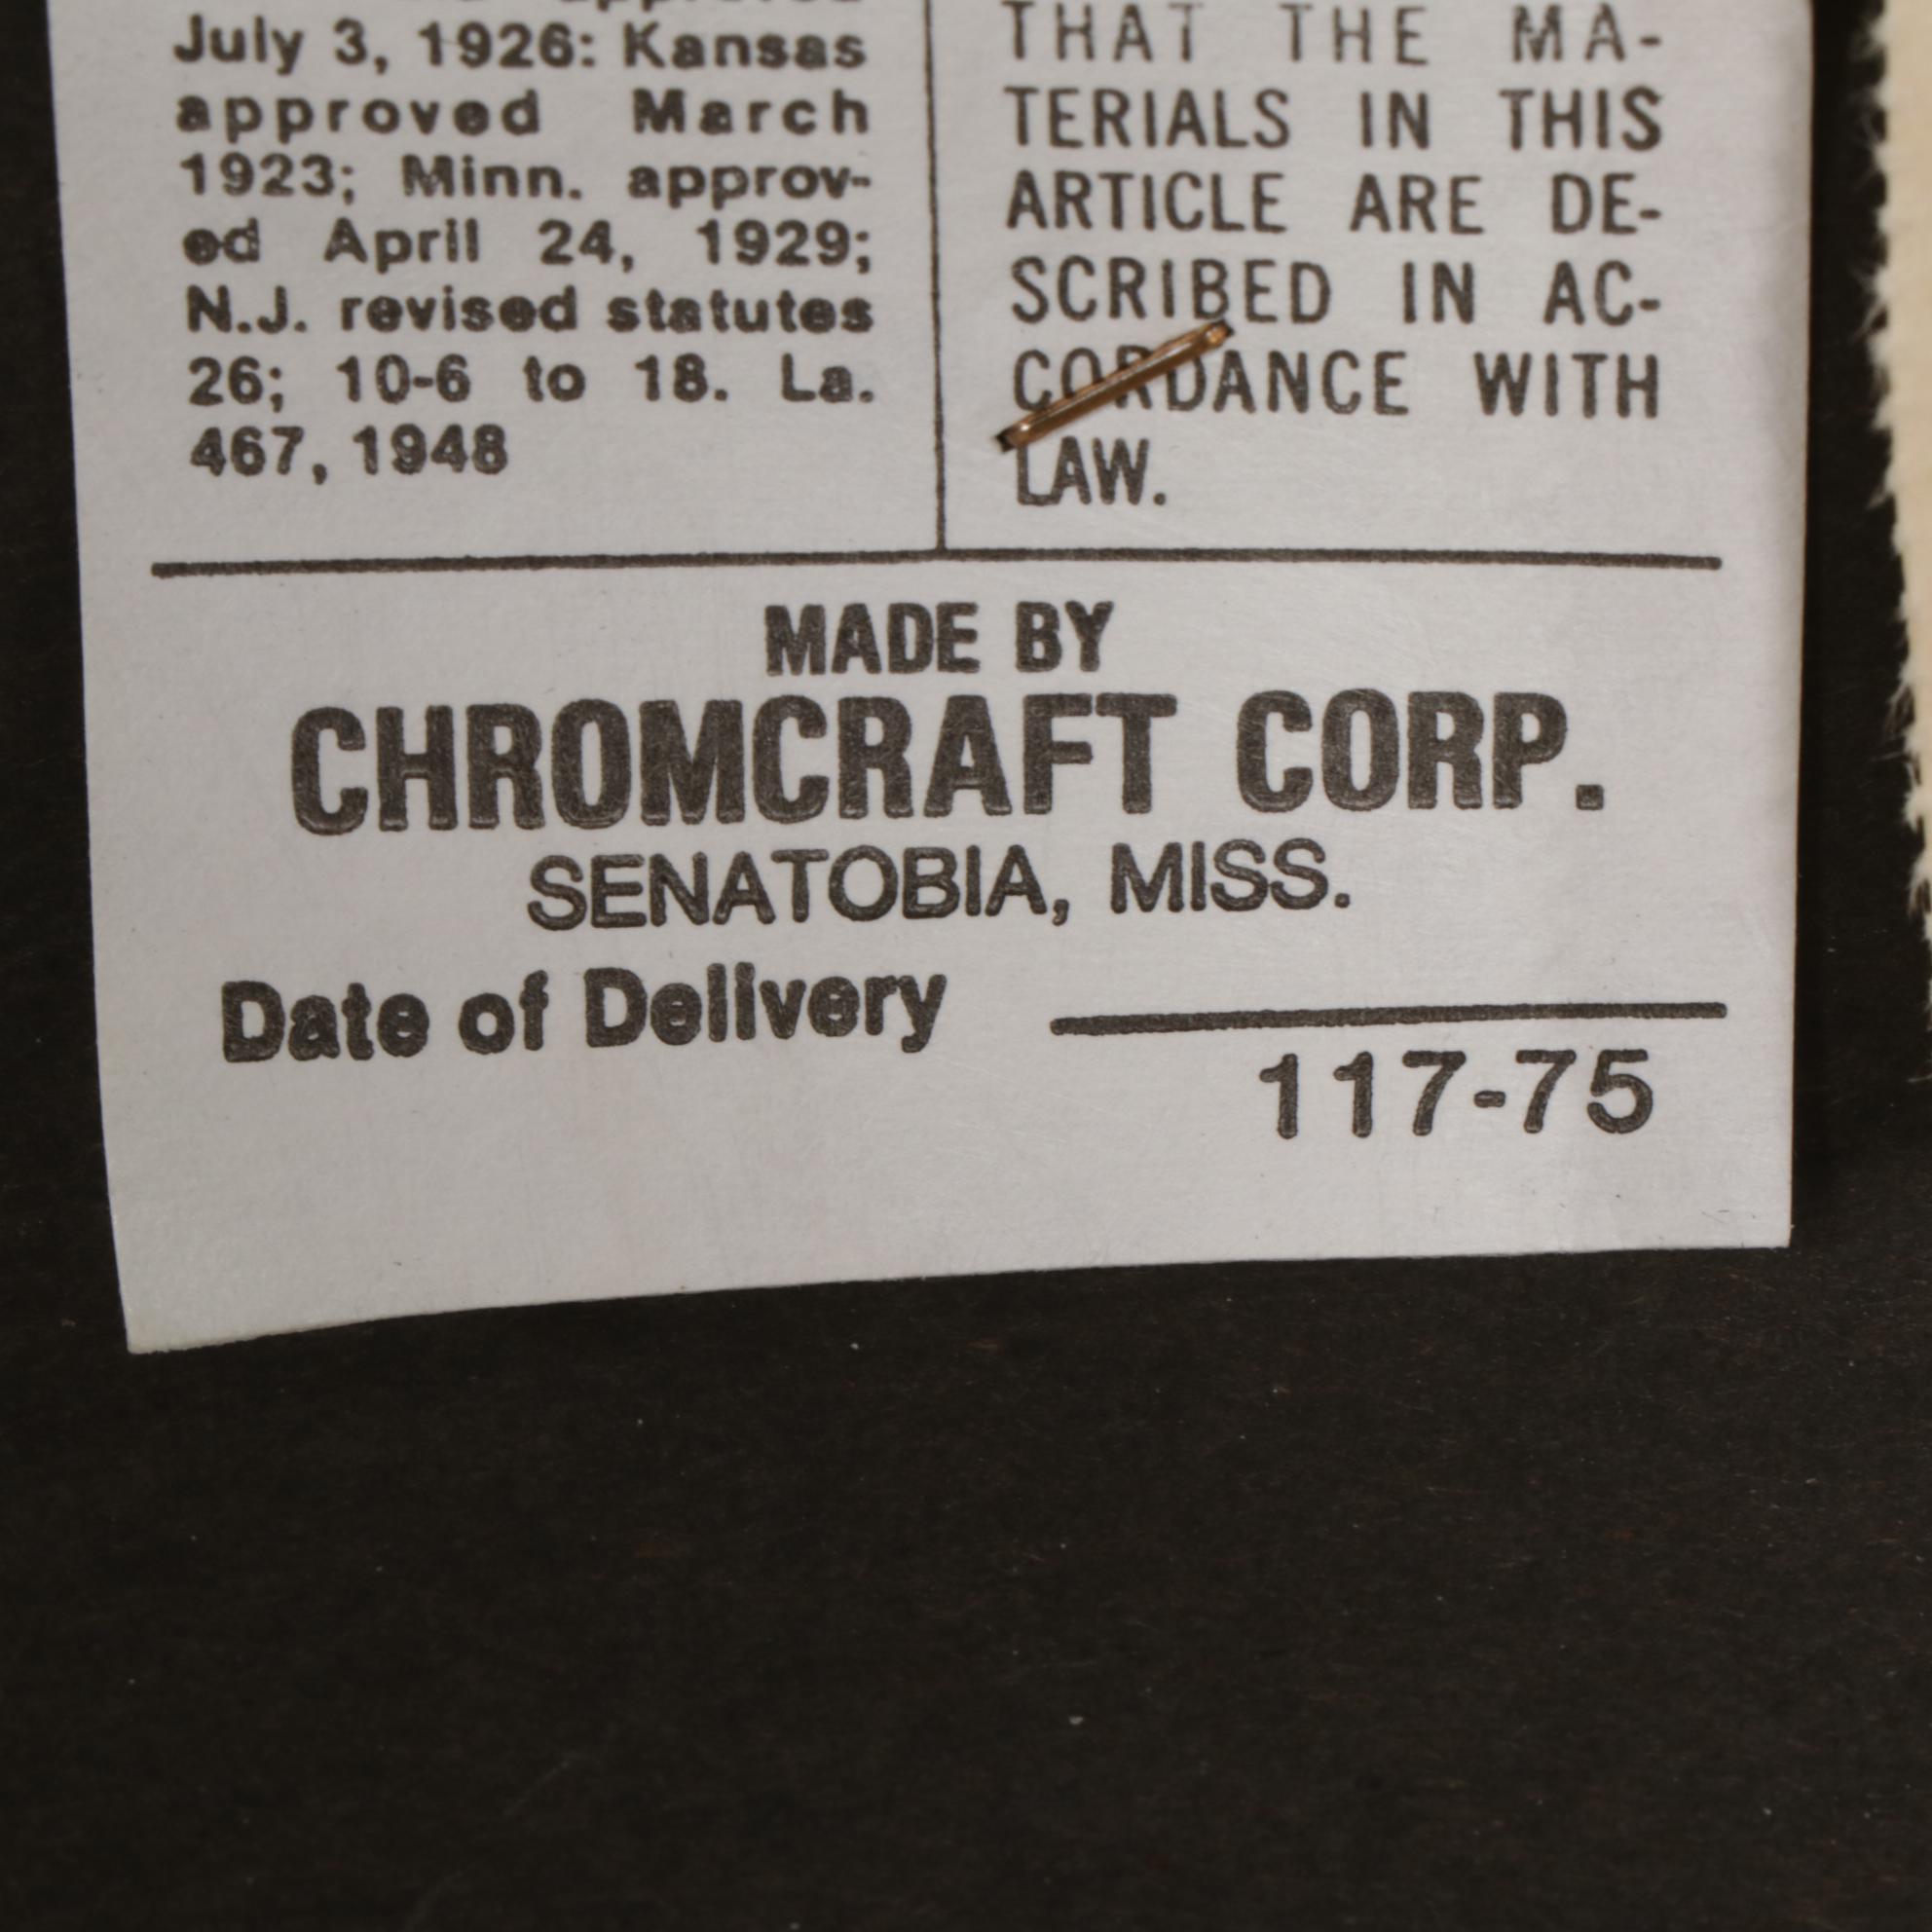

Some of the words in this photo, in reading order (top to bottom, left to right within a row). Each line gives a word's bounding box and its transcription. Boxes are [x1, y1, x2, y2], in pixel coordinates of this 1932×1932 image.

[173, 15, 305, 77] July
[332, 17, 389, 76] 3,
[418, 21, 595, 69] 1926:
[622, 21, 866, 70] Kansas
[1001, 0, 1206, 63] THAT
[1280, 3, 1428, 66] THE
[1512, 2, 1661, 62] MA-
[176, 89, 539, 145] approved
[632, 88, 868, 135] March
[1004, 86, 1289, 149] TERIALS
[1360, 92, 1430, 150] IN
[1498, 85, 1663, 153] THIS
[180, 151, 353, 205] 1923;
[401, 154, 581, 200] Minn.
[627, 166, 871, 210] approv-
[1006, 169, 1286, 234] ARTICLE
[1350, 173, 1483, 235] ARE
[1551, 172, 1661, 235] DE-
[182, 216, 261, 267] ed
[323, 217, 479, 274] April
[538, 219, 633, 273] 24,
[696, 219, 871, 275] 1929;
[186, 285, 307, 334] N.J.
[340, 284, 577, 333] revised
[607, 288, 873, 334] statutes
[1010, 253, 1332, 325] SCRIBED
[1402, 262, 1474, 324] IN
[1543, 260, 1660, 327] AC-
[188, 355, 283, 413] 26;
[336, 353, 470, 405] 10-6
[523, 355, 585, 402] to
[635, 353, 727, 403] 18.
[781, 353, 873, 404] La.
[1013, 345, 1410, 417] CORDANCE
[1473, 352, 1658, 419] WITH
[190, 426, 327, 485] 467,
[353, 424, 507, 475] 1948
[1016, 435, 1167, 507] LAW.
[764, 602, 980, 677] MADE
[1015, 601, 1113, 673] BY
[290, 692, 1177, 836] CHROMCRAFT
[1236, 688, 1604, 813] CORP.
[526, 844, 1069, 932] SENATOBIA,
[1110, 837, 1350, 914] MISS.
[221, 981, 429, 1063] Date
[458, 970, 549, 1056] of
[582, 961, 947, 1054] Delivery
[1258, 1049, 1653, 1140] 117-75
